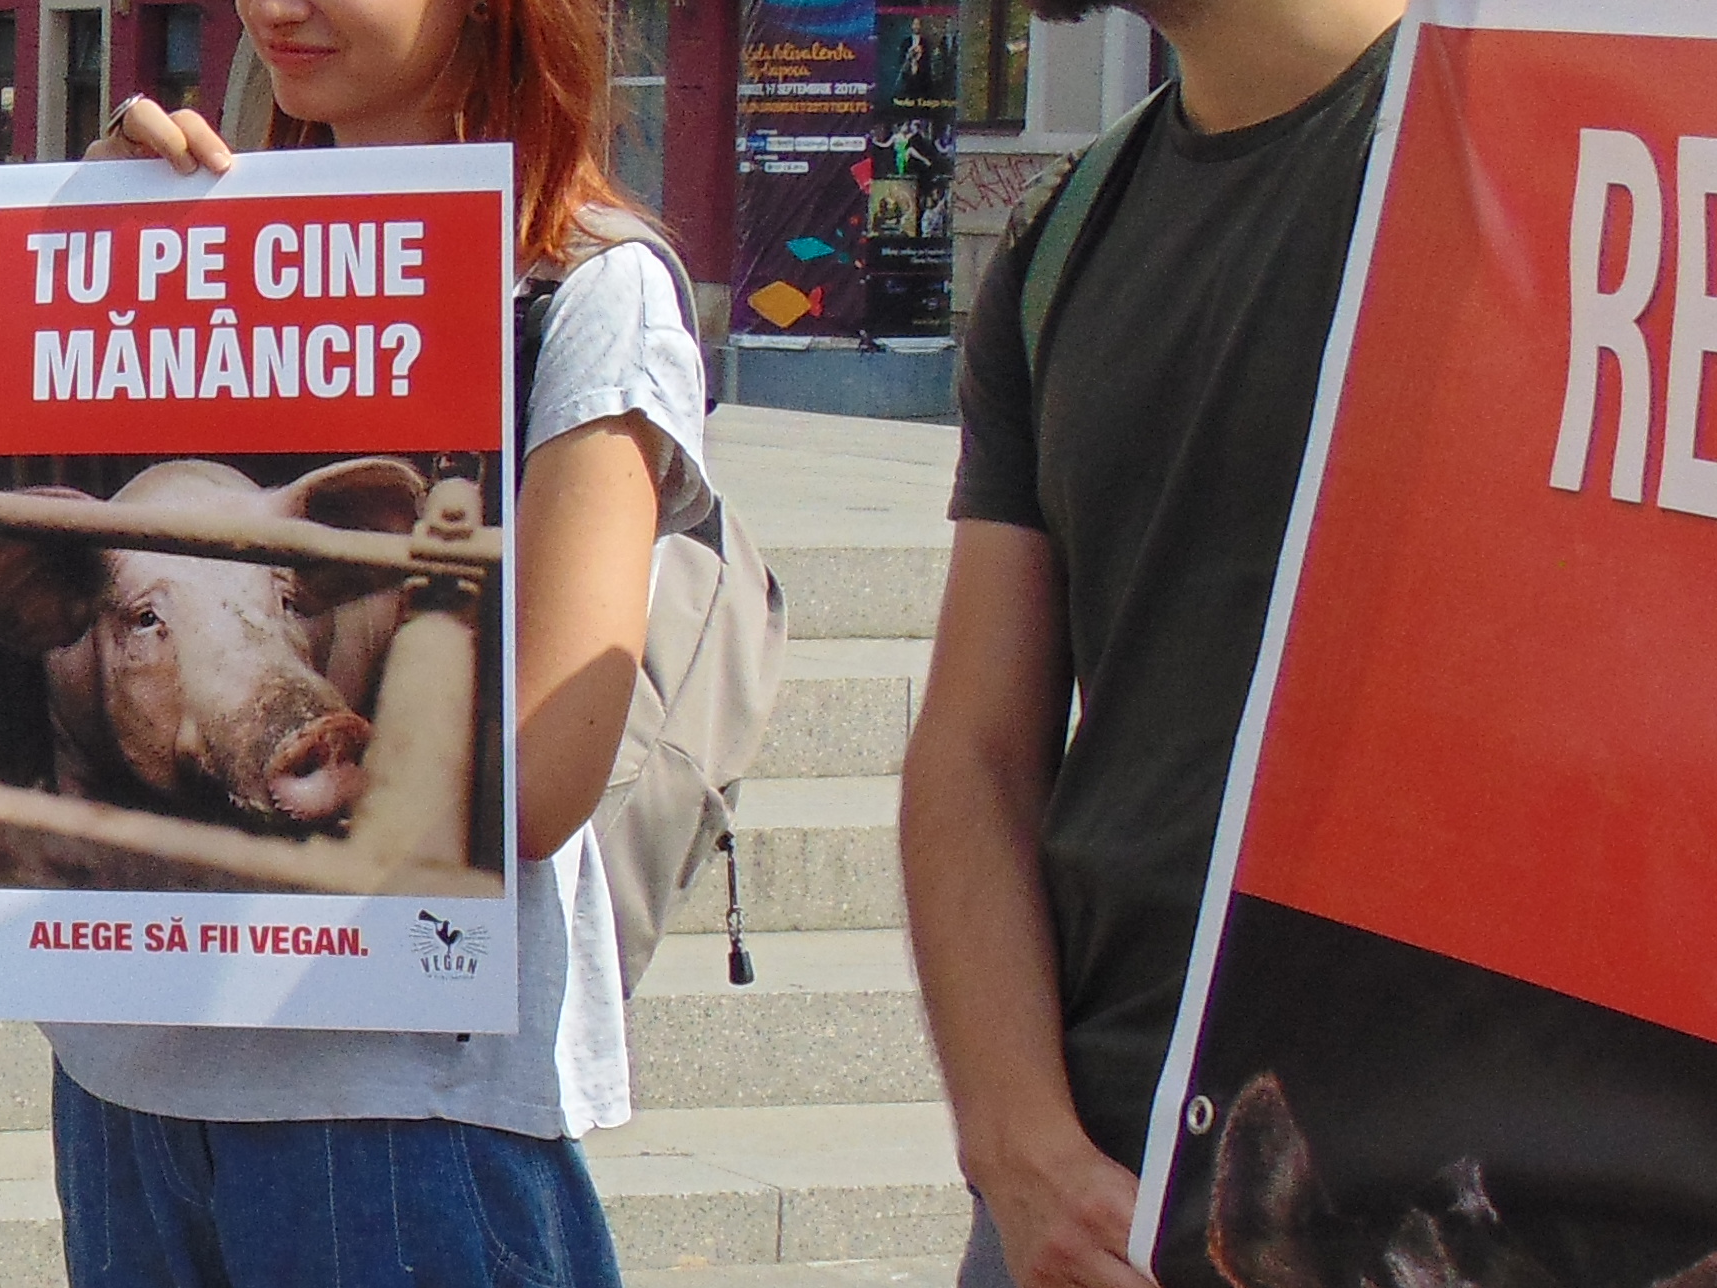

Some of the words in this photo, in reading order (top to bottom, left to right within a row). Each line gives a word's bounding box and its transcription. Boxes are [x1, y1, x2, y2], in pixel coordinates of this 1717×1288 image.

[26, 229, 112, 305] TU
[138, 224, 226, 302] PE
[253, 220, 426, 299] CINE
[32, 309, 424, 403] MĂNÂNCI?
[28, 919, 134, 953] ALEGE
[143, 916, 191, 953] SĂ
[199, 925, 241, 955] FII
[247, 925, 369, 958] VEGAN.
[420, 954, 478, 975] VEGAN
